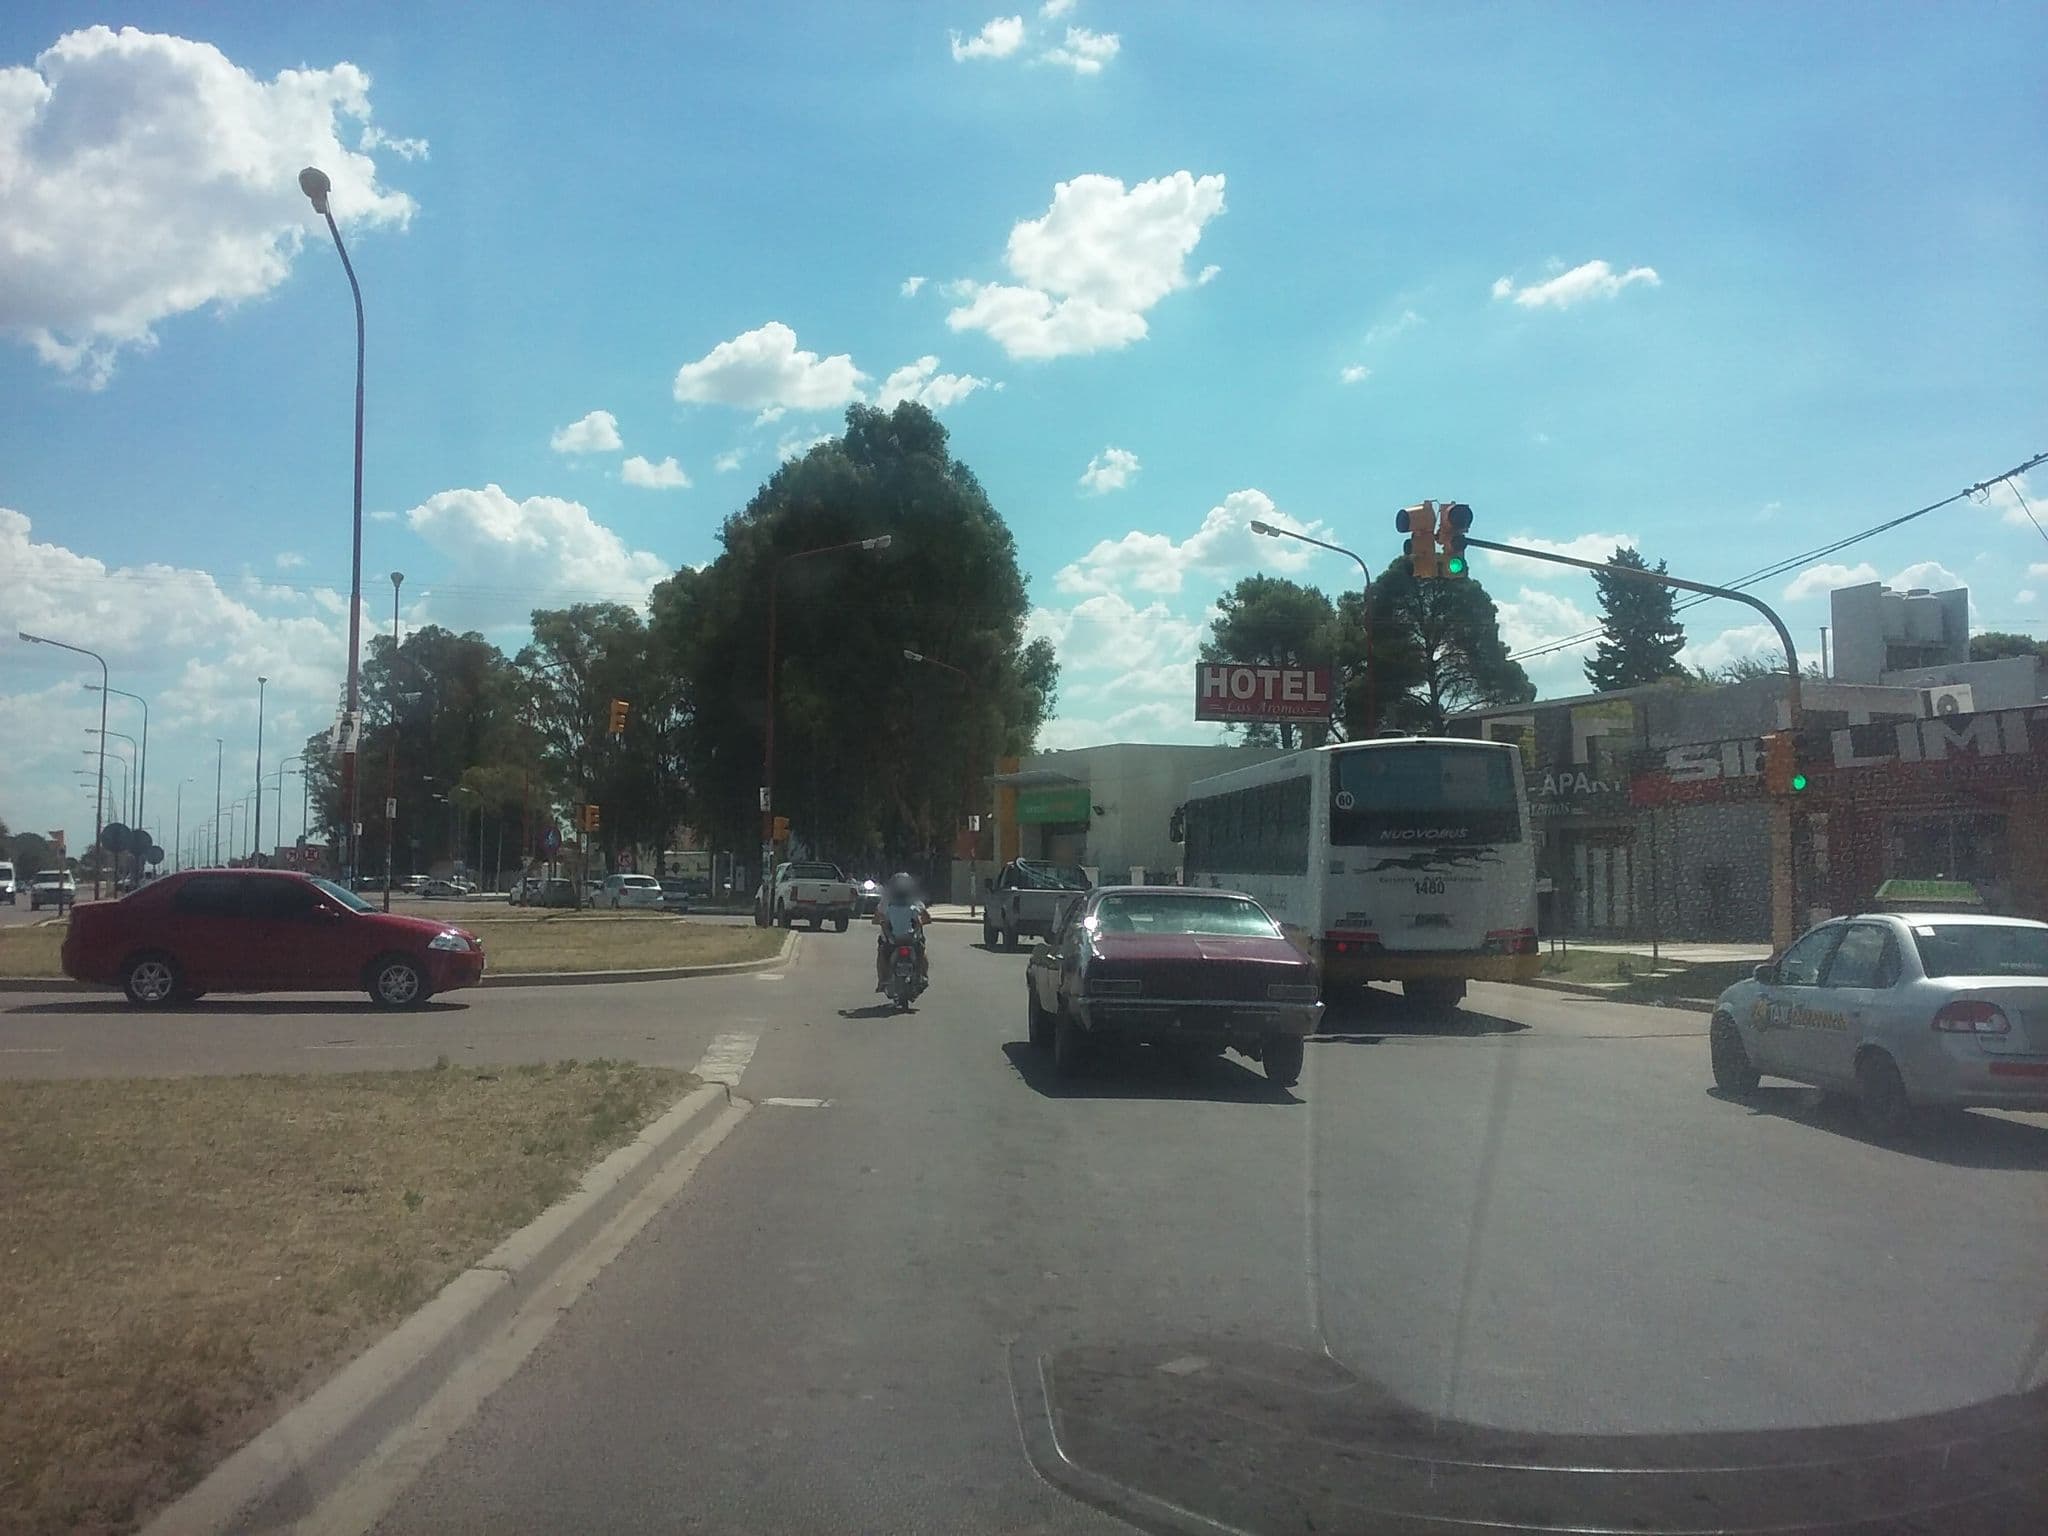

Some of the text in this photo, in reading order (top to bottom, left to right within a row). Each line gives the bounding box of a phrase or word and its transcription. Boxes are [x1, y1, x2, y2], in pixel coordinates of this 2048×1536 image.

[1203, 667, 1327, 701] HOTEL
[1831, 700, 2048, 769] LIMI
[1337, 792, 1352, 806] 60
